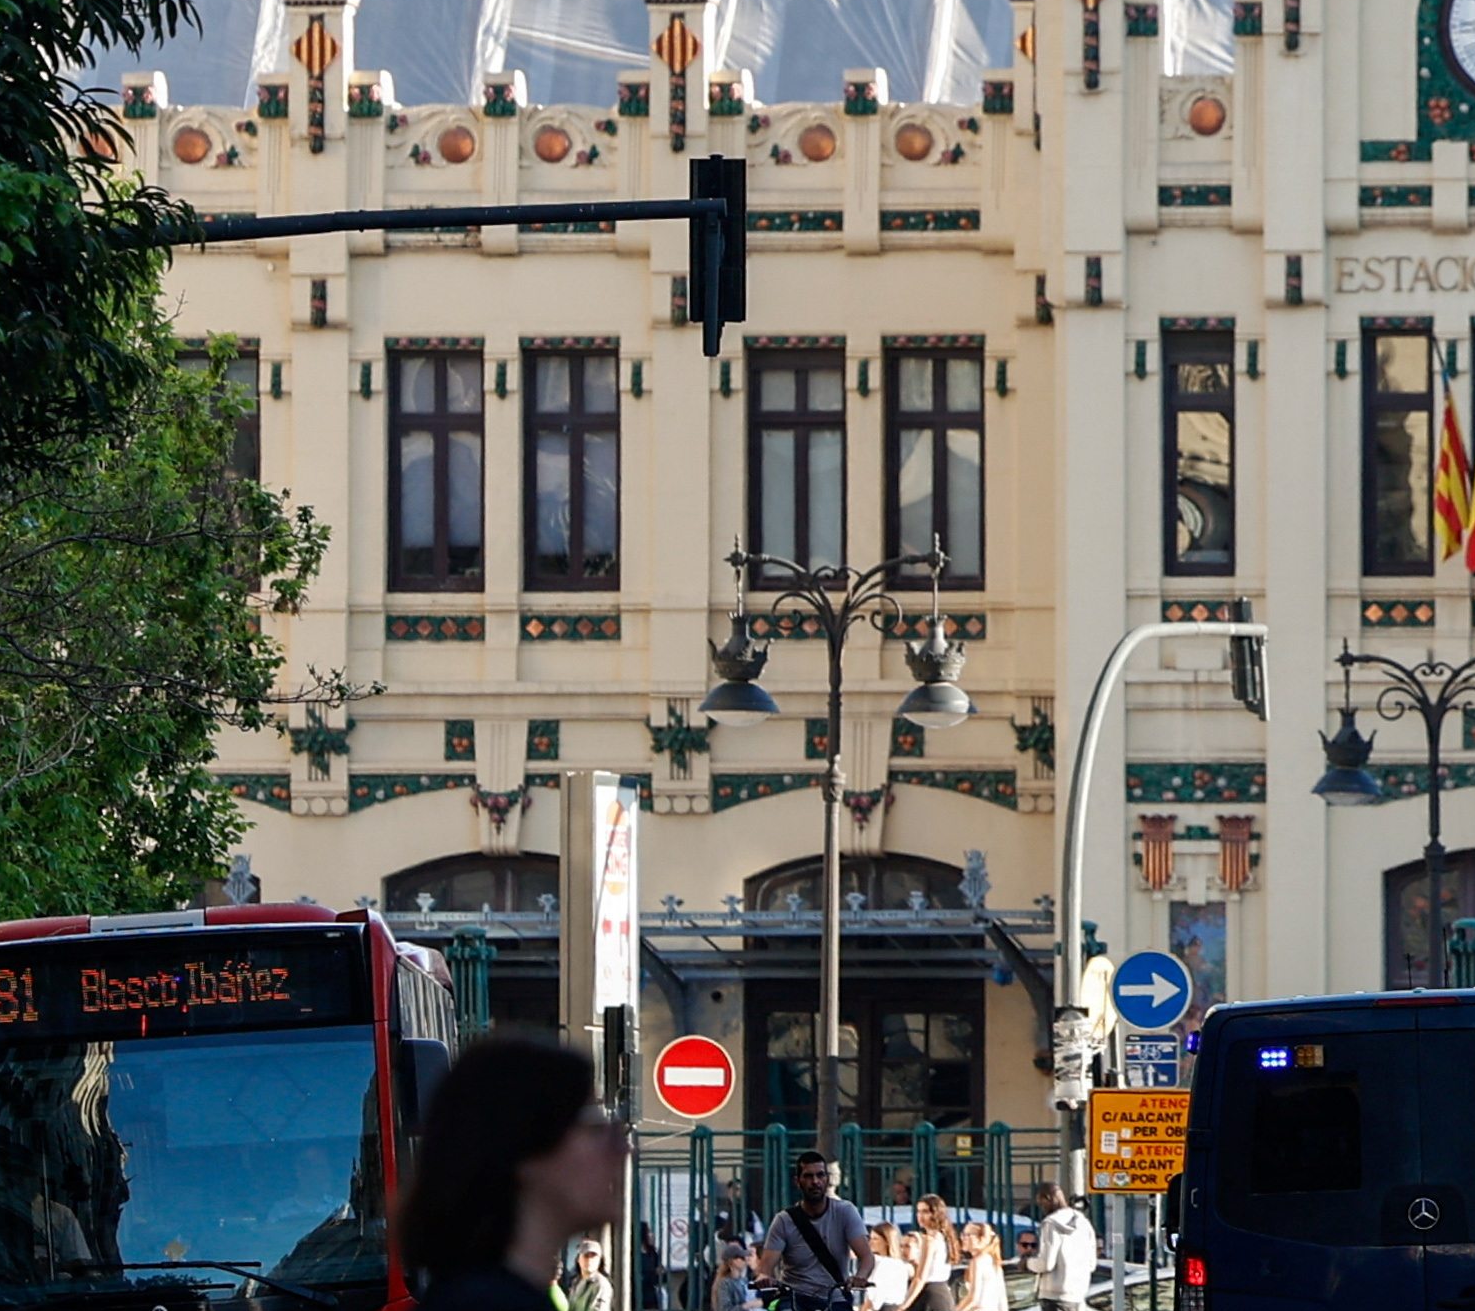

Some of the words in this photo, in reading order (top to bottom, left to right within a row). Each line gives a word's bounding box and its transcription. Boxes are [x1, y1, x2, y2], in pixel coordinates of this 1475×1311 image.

[80, 968, 178, 1013] Blasco
[183, 960, 291, 1006] Ibáñez
[1139, 1098, 1189, 1109] ATENC
[1133, 1126, 1158, 1137] PER
[1135, 1146, 1183, 1156] ATENC
[1131, 1174, 1157, 1184] POR
